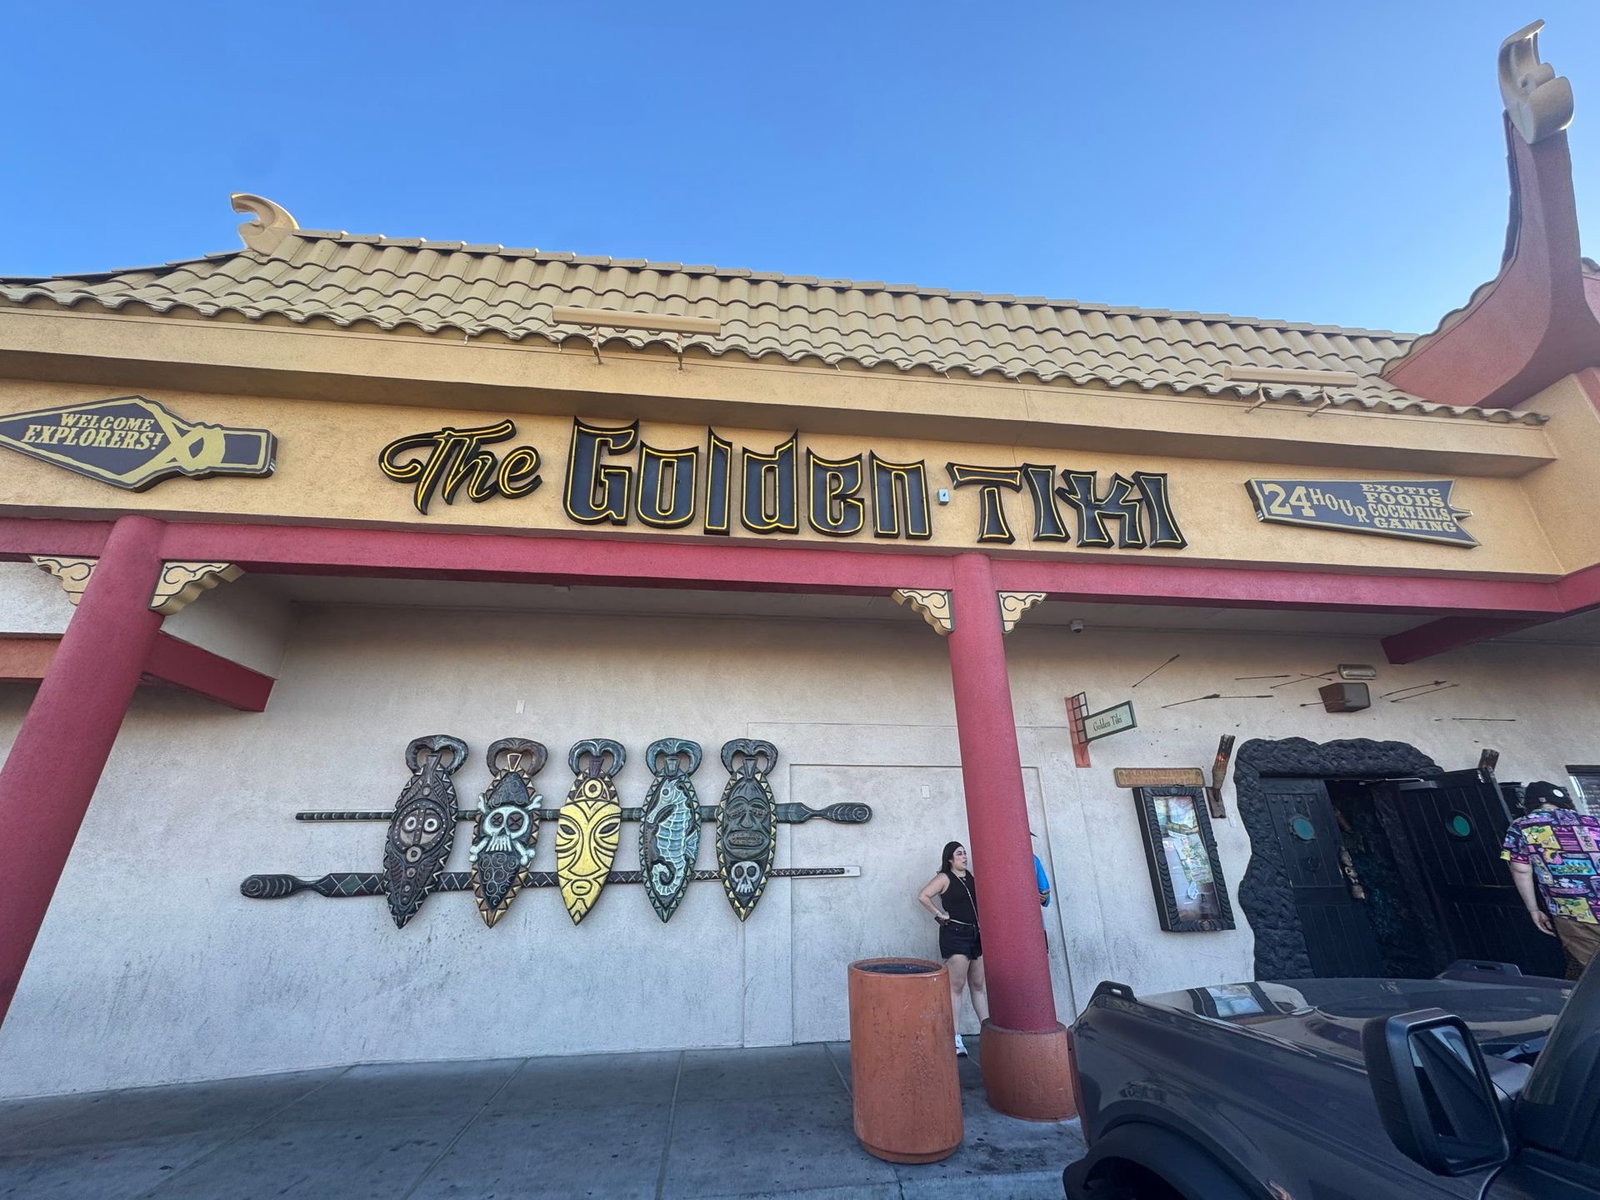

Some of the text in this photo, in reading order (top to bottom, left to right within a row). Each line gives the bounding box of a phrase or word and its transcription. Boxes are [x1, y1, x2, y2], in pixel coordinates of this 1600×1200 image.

[60, 413, 155, 432] WELCOME
[21, 425, 164, 450] EXPLORERS!
[379, 415, 1188, 550] The Golden TIKI
[1360, 484, 1441, 497] EXOTIC
[1263, 484, 1370, 523] 24 HOUR
[1365, 492, 1445, 507] FOODS
[1369, 504, 1451, 522] COCKTAILS
[1375, 518, 1457, 532] GAMING
